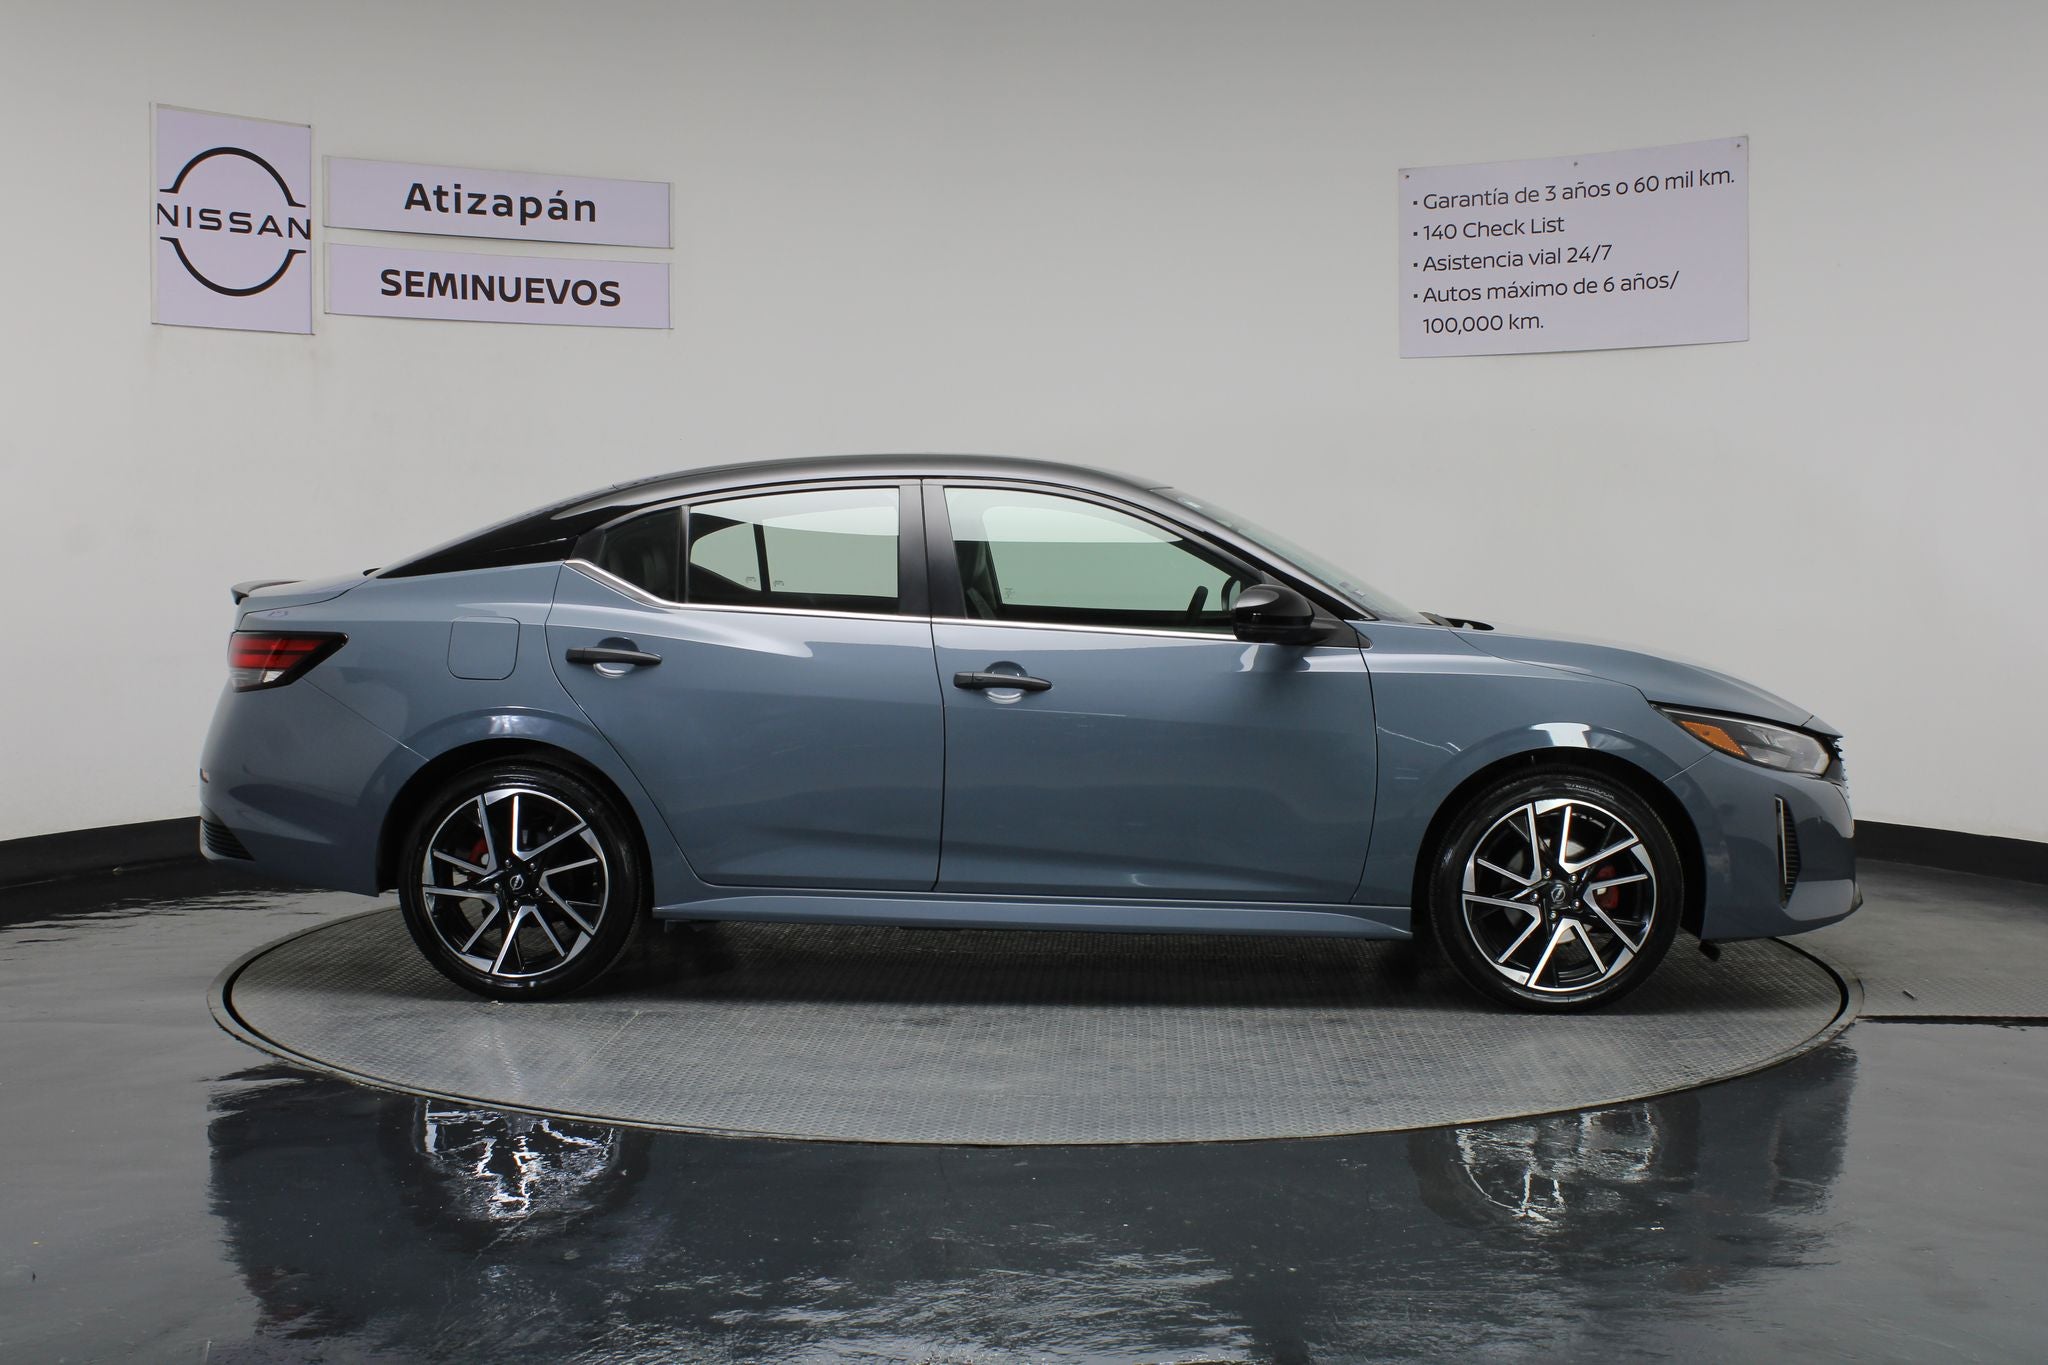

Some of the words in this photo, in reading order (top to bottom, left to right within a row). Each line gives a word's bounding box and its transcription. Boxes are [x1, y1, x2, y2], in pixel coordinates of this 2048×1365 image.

[403, 182, 597, 226] Atizapán
[1423, 187, 1509, 210] Garantía
[1514, 185, 1540, 204] de
[1544, 185, 1557, 202] 3
[1562, 180, 1611, 200] años
[1615, 182, 1629, 196] o
[1633, 175, 1660, 194] 60
[1665, 171, 1694, 191] mil
[1699, 169, 1736, 187] km.
[156, 201, 311, 241] NISSAN
[1423, 223, 1458, 241] 140
[1462, 218, 1526, 239] Check
[1531, 216, 1566, 234] List
[1422, 251, 1525, 273] Asistencia
[1528, 247, 1562, 266] vial
[1566, 244, 1613, 264] 24/7
[380, 268, 621, 308] SEMINUEVOS
[1422, 286, 1482, 303] Autos
[1486, 278, 1569, 300] máximo
[1573, 276, 1599, 295] de
[1603, 276, 1616, 293] 6
[1620, 270, 1681, 292] años/
[1422, 314, 1504, 336] 100,000
[1508, 312, 1545, 331] km.
